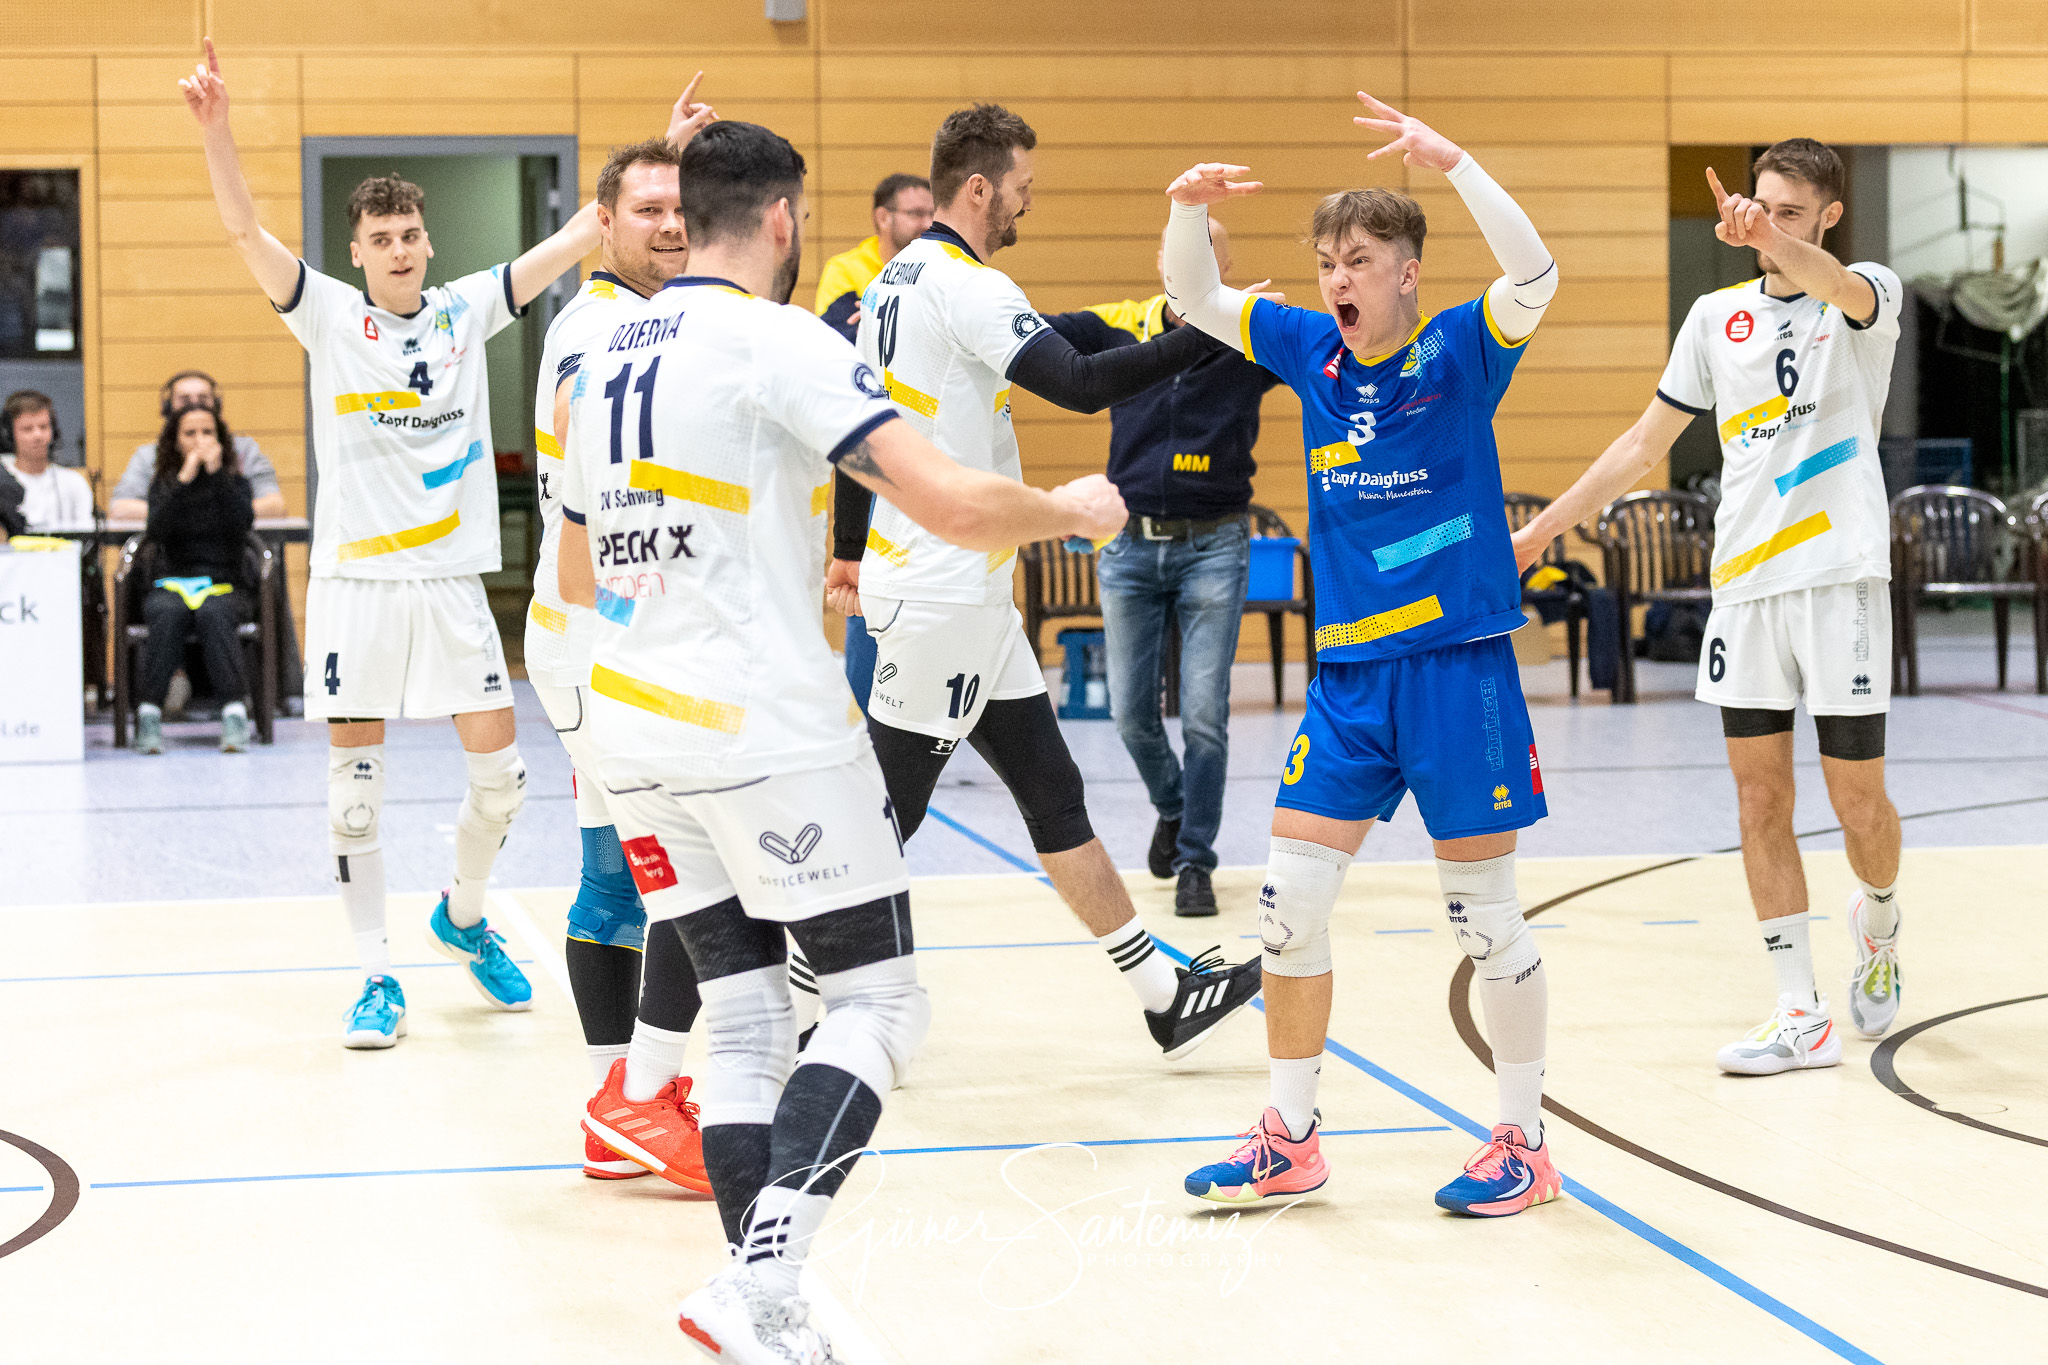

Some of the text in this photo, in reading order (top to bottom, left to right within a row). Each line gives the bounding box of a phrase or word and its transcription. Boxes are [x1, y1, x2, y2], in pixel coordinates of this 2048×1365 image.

[877, 295, 899, 368] 10
[408, 361, 433, 396] 4
[1776, 348, 1799, 397] 6
[378, 412, 408, 427] Zapf
[604, 355, 661, 464] 11
[1347, 411, 1376, 446] 3
[1784, 401, 1816, 423] gfuss
[1173, 453, 1211, 472] MM
[1331, 468, 1428, 488] Zapf Daigfuss
[598, 527, 659, 567] PECK
[0, 594, 39, 624] ck
[325, 652, 341, 695] 4
[1709, 637, 1726, 683] 6
[946, 672, 980, 719] 10
[1283, 734, 1310, 785] 3
